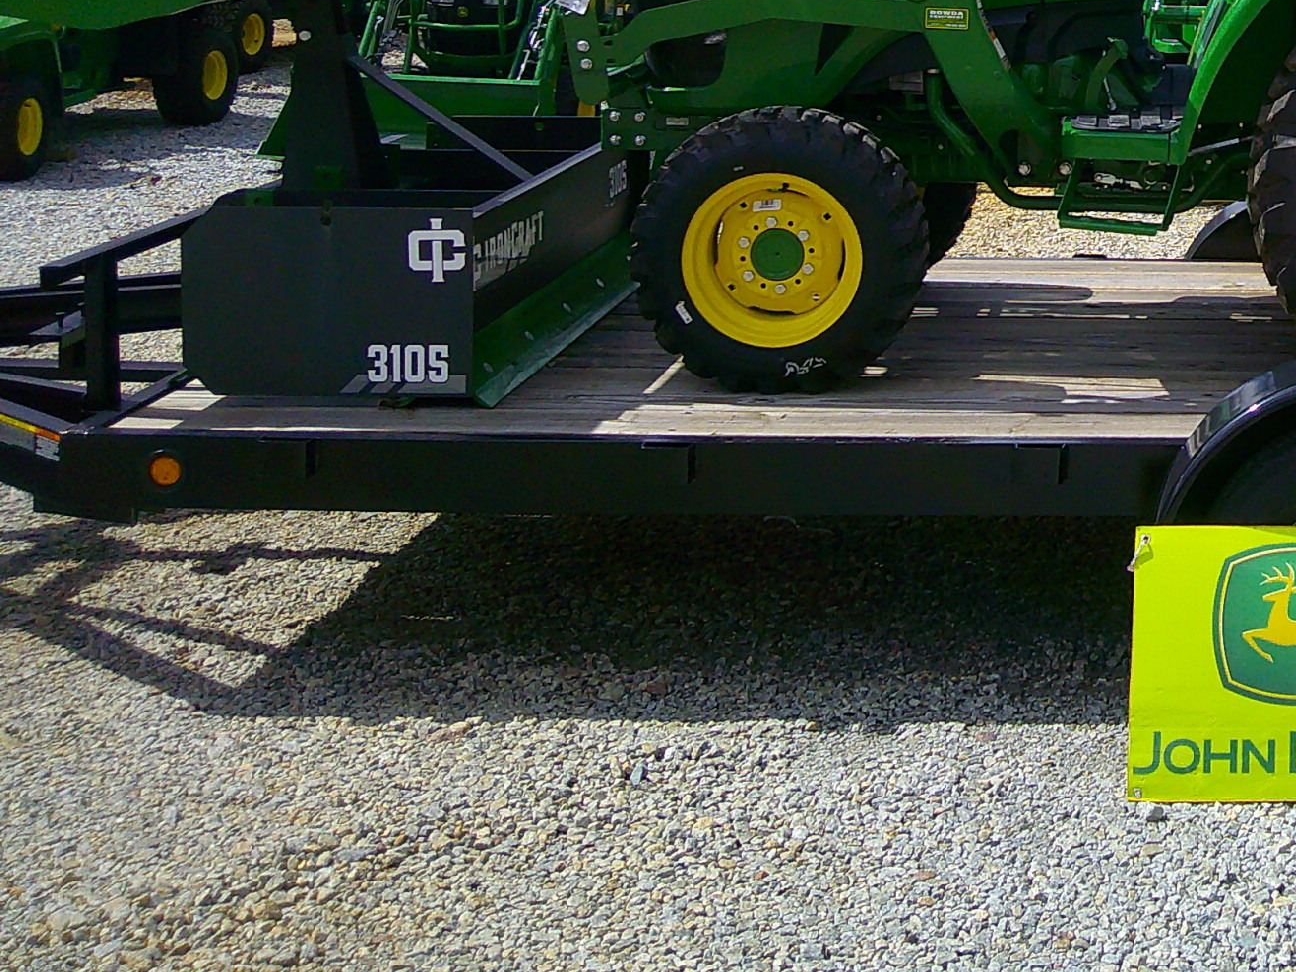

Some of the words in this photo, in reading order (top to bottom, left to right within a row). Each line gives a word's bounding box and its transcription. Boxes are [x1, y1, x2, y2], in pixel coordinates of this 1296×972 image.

[484, 210, 545, 272] IRONCRAFT
[366, 344, 450, 385] 3105
[1133, 730, 1276, 776] JOHN
